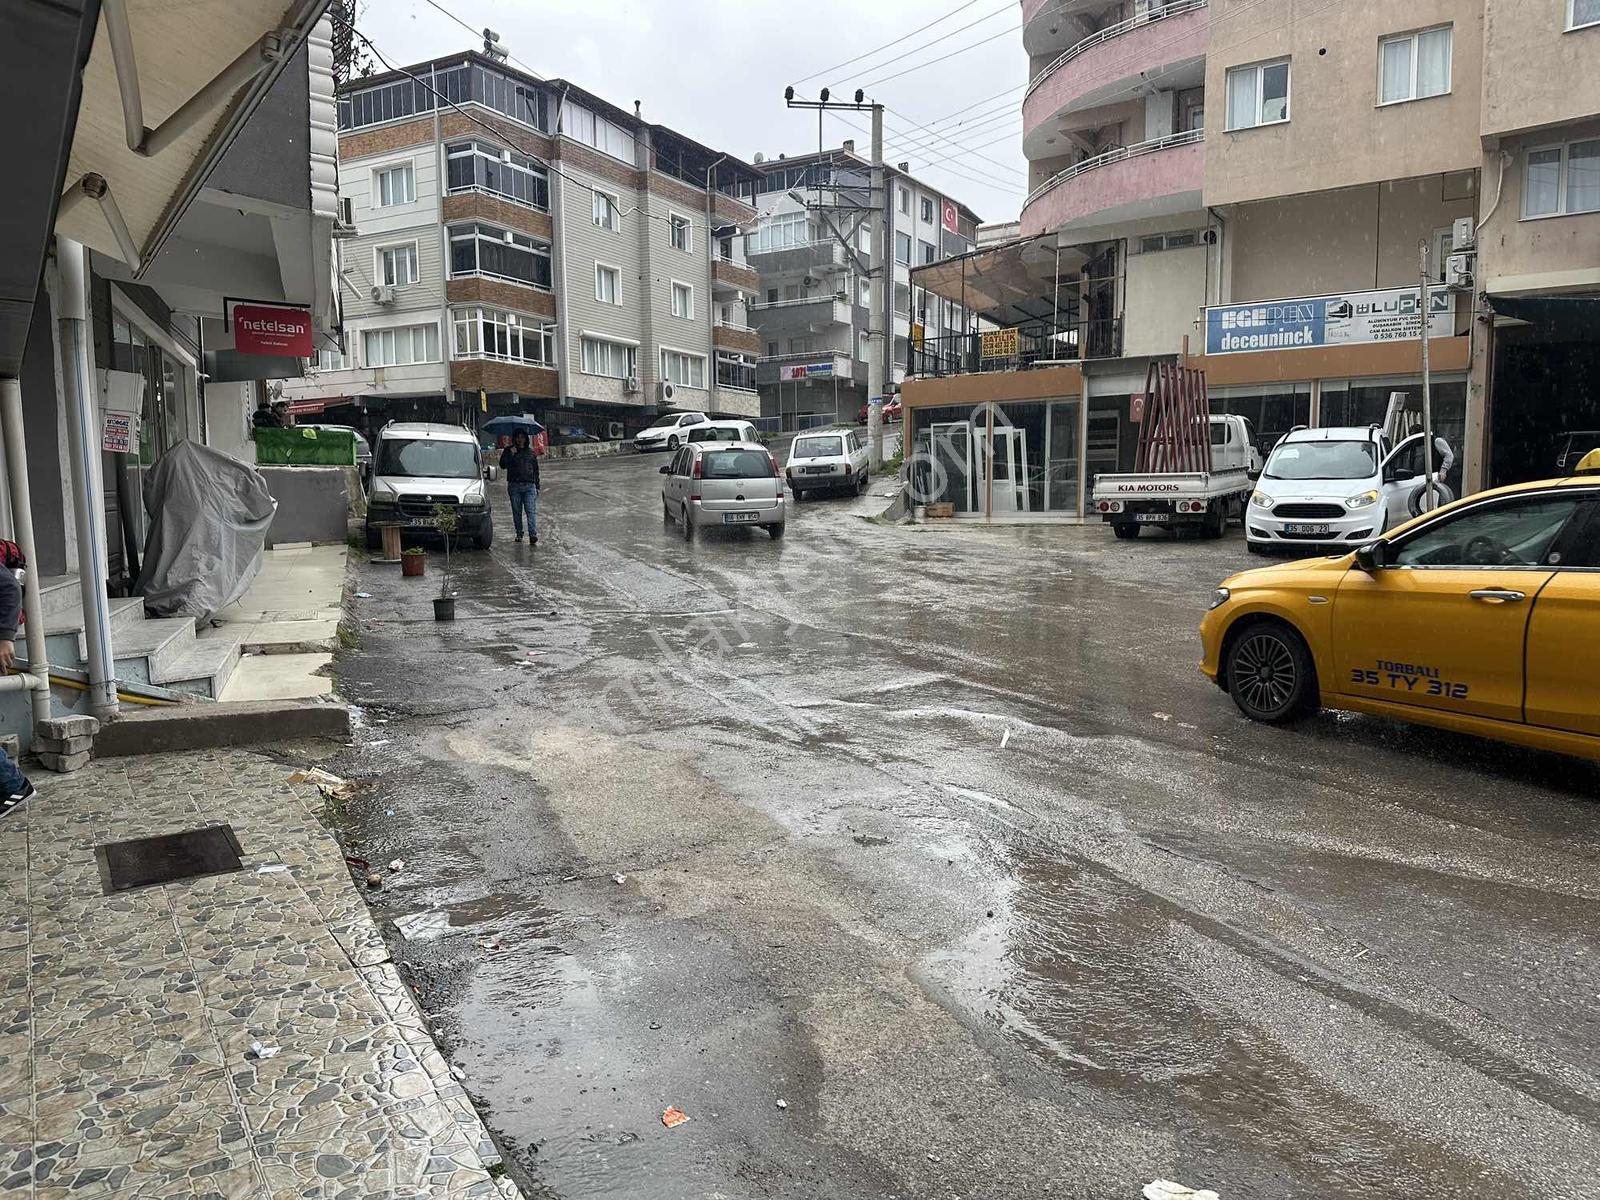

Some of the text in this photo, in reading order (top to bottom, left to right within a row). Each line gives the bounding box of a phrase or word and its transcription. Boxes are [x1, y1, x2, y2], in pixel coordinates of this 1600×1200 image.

[243, 319, 304, 334] netelsan
[1222, 304, 1314, 329] EGEPEN
[983, 335, 1016, 344] SATILIK
[1221, 326, 1313, 350] deceuninck
[1118, 484, 1179, 492] KIA MOTORS
[1376, 659, 1440, 679] TORBALI
[1351, 669, 1469, 699] 35 TY 312
